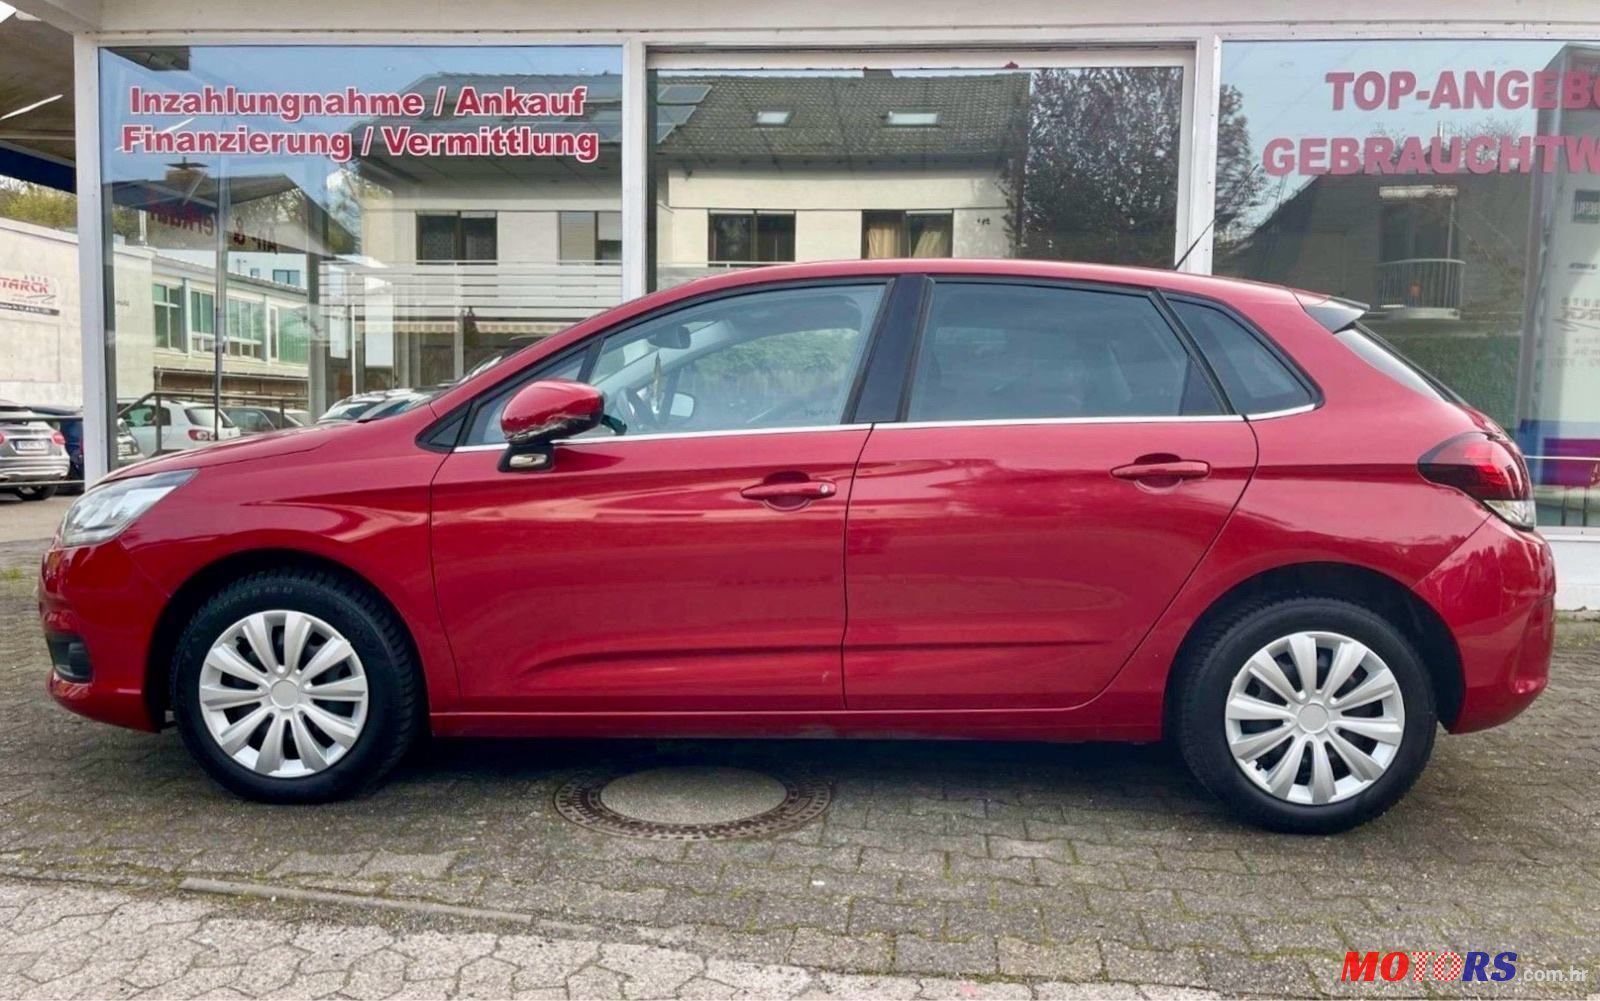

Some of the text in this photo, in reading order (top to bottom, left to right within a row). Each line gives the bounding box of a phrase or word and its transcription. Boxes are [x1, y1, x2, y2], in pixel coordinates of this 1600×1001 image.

[130, 86, 587, 121] Inzahlungnahme / Ankauf
[1325, 70, 1600, 111] TOP-ANGEB
[121, 125, 599, 163] Finanzierung / Vermittlung
[0, 276, 49, 294] TARCK
